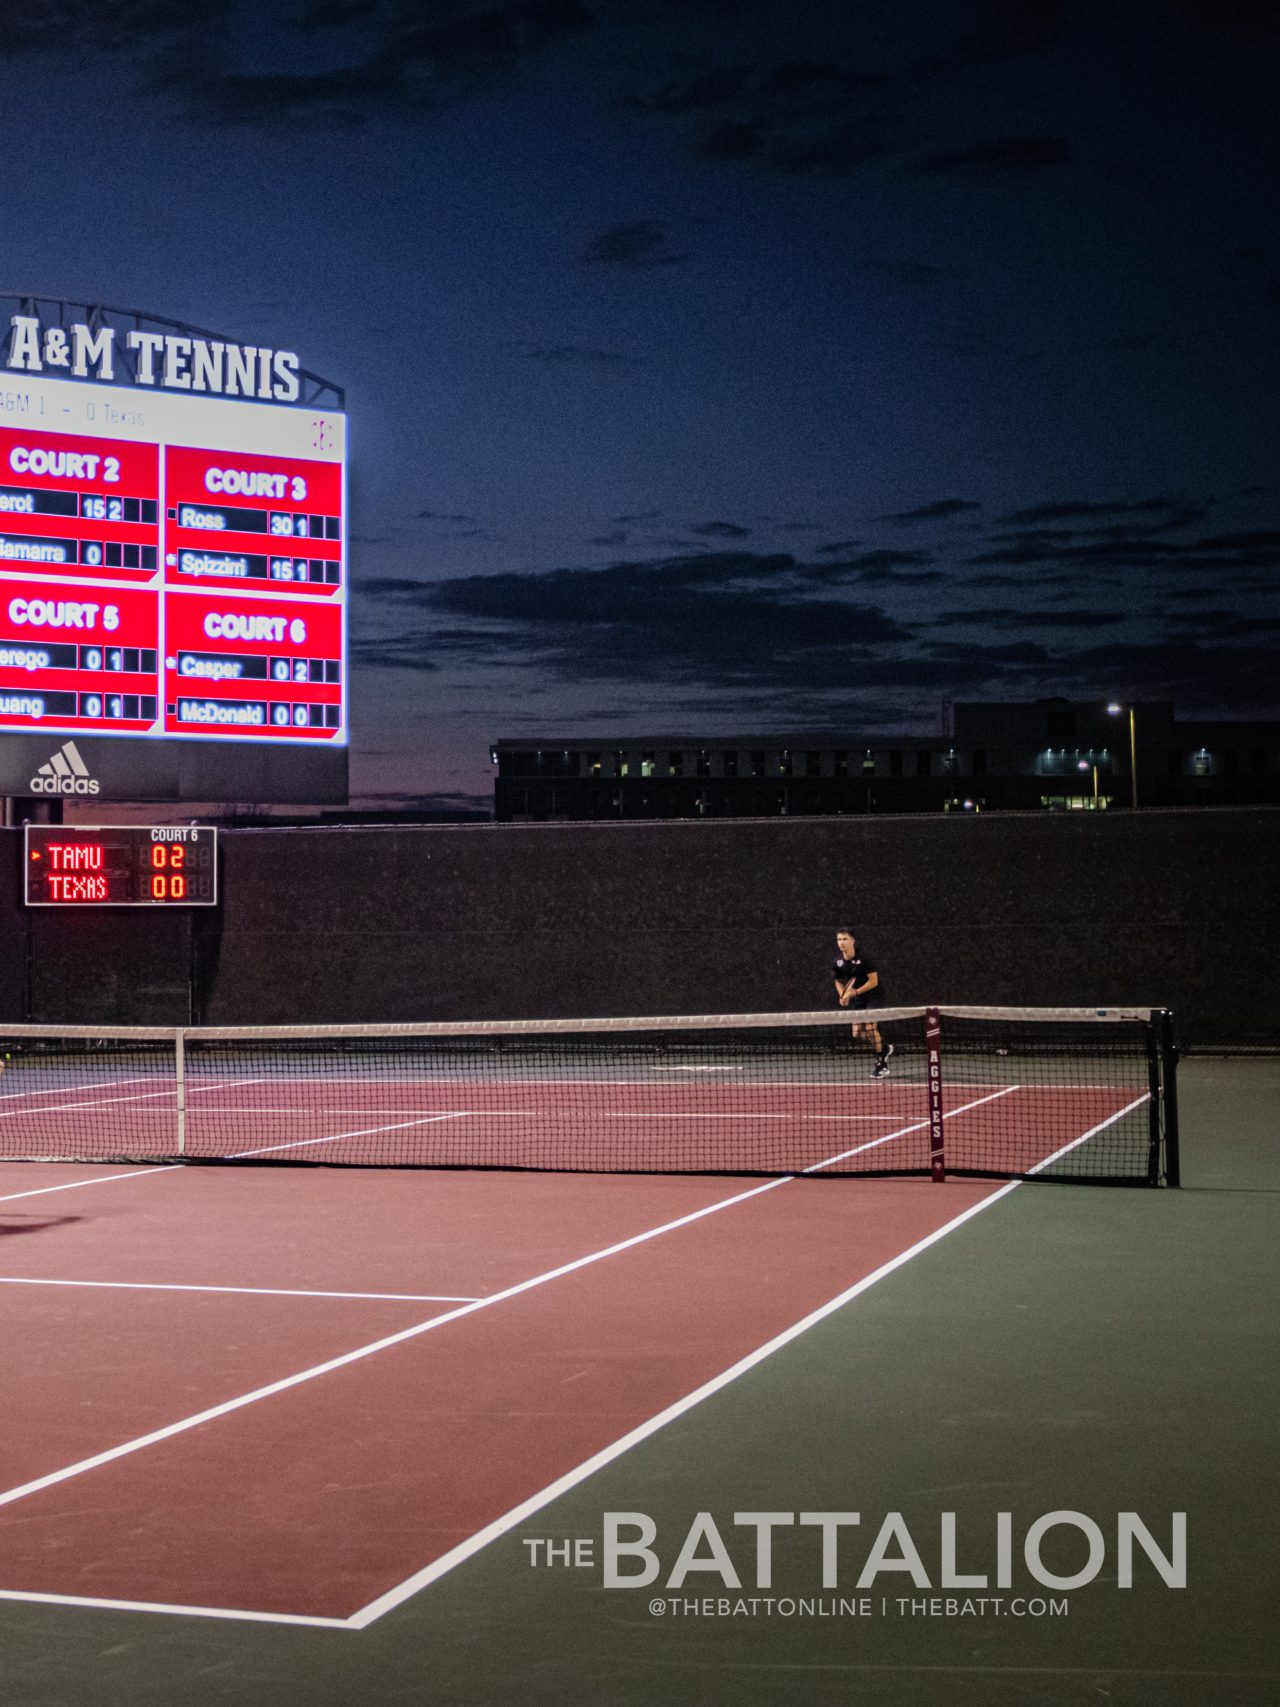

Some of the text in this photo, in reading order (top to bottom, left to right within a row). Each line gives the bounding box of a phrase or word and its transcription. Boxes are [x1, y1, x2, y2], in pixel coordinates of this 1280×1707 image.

[7, 315, 114, 380] A&M
[127, 330, 299, 402] TENNIS
[104, 403, 145, 426] Texas
[10, 447, 120, 482] COURT 2
[205, 467, 307, 501] COURT 3
[84, 498, 105, 518] 15
[109, 501, 121, 520] 2
[181, 508, 306, 536] Ross 30 1
[87, 545, 101, 565] 0
[272, 561, 292, 580] 15
[297, 563, 307, 581] 1
[8, 598, 120, 631] COURT 5
[204, 612, 306, 644] COURT 6
[87, 650, 101, 670] 0
[111, 651, 121, 671] 1
[181, 656, 307, 681] Casper 0 2
[86, 697, 101, 716] 0
[111, 698, 121, 717] 1
[181, 701, 307, 726] McDonald 0 0
[30, 774, 100, 794] adidas
[151, 829, 198, 842] COURT 6
[48, 846, 101, 869] TAMU
[48, 876, 106, 899] TEXAS
[930, 1050, 941, 1138] AGGIES
